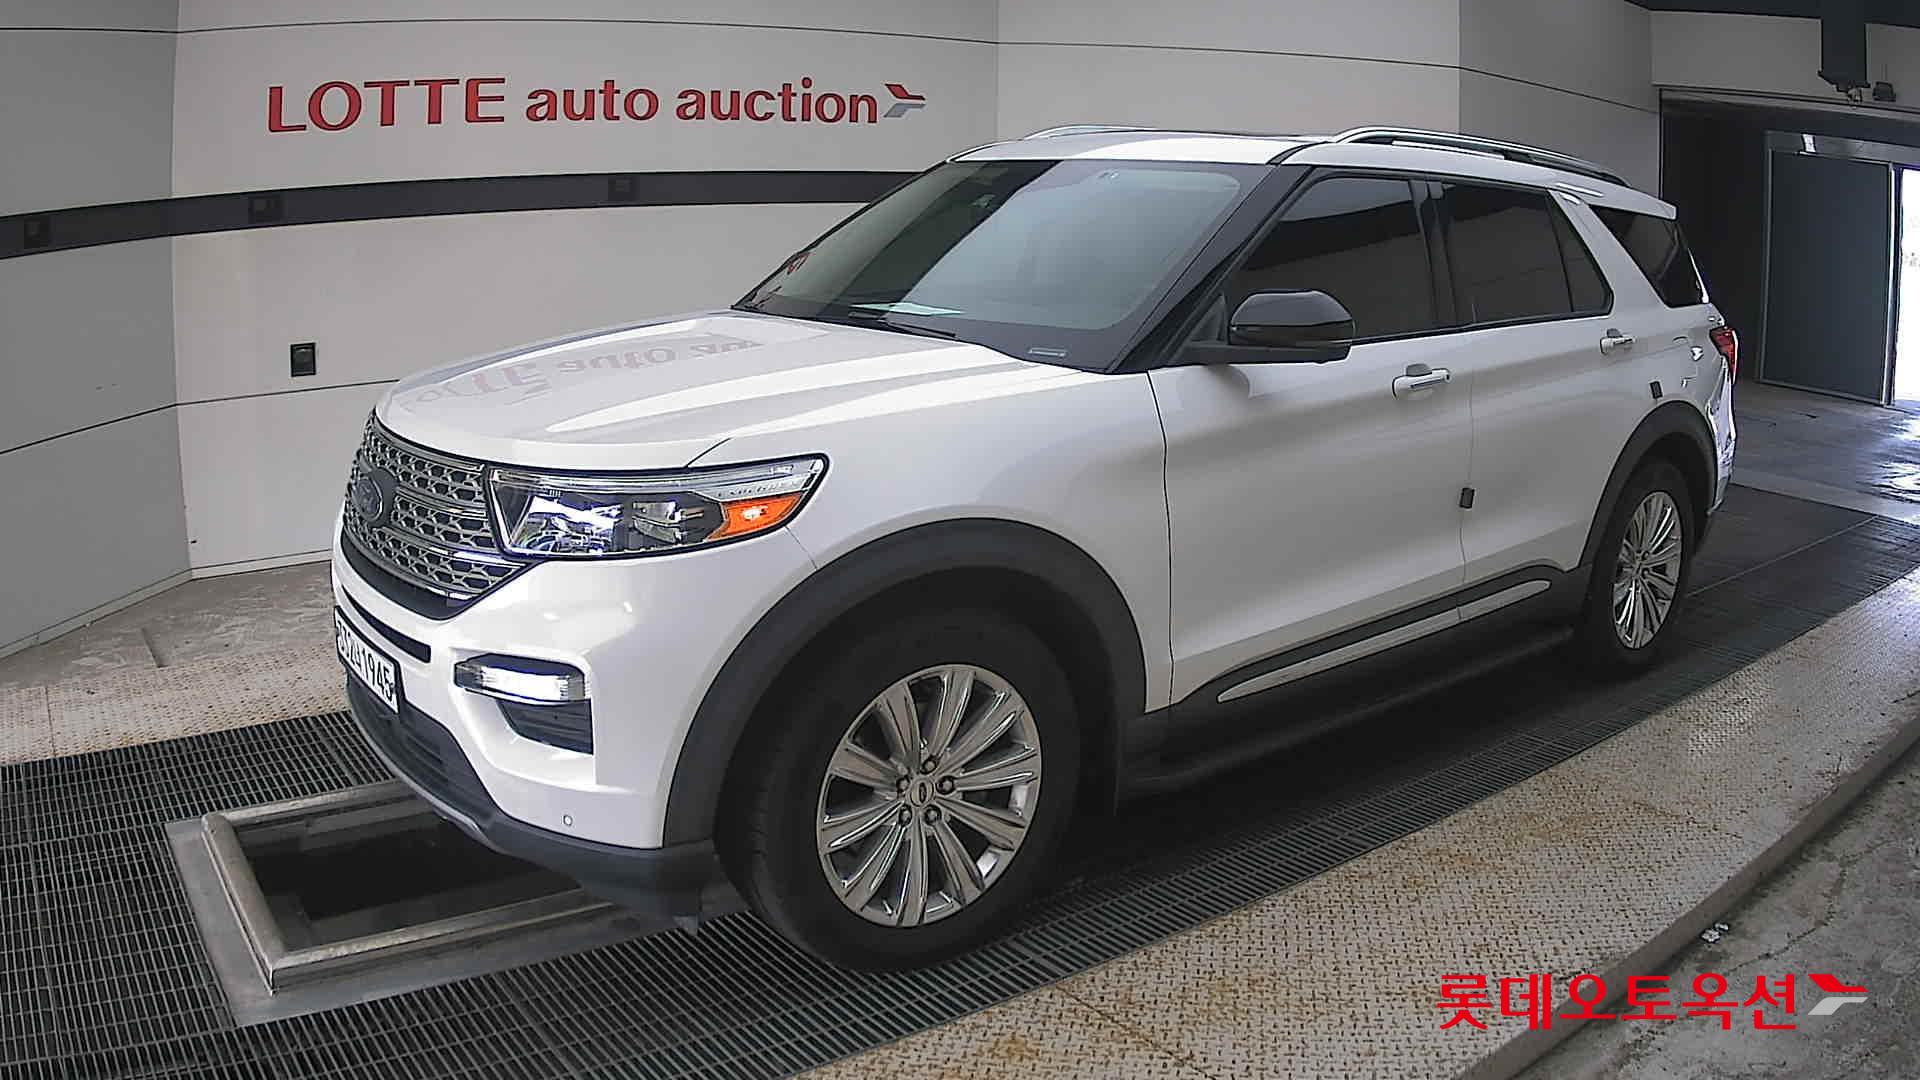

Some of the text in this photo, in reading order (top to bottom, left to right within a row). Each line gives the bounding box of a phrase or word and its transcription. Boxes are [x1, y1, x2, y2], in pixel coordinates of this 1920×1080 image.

[268, 77, 878, 133] LOTTE auto auction
